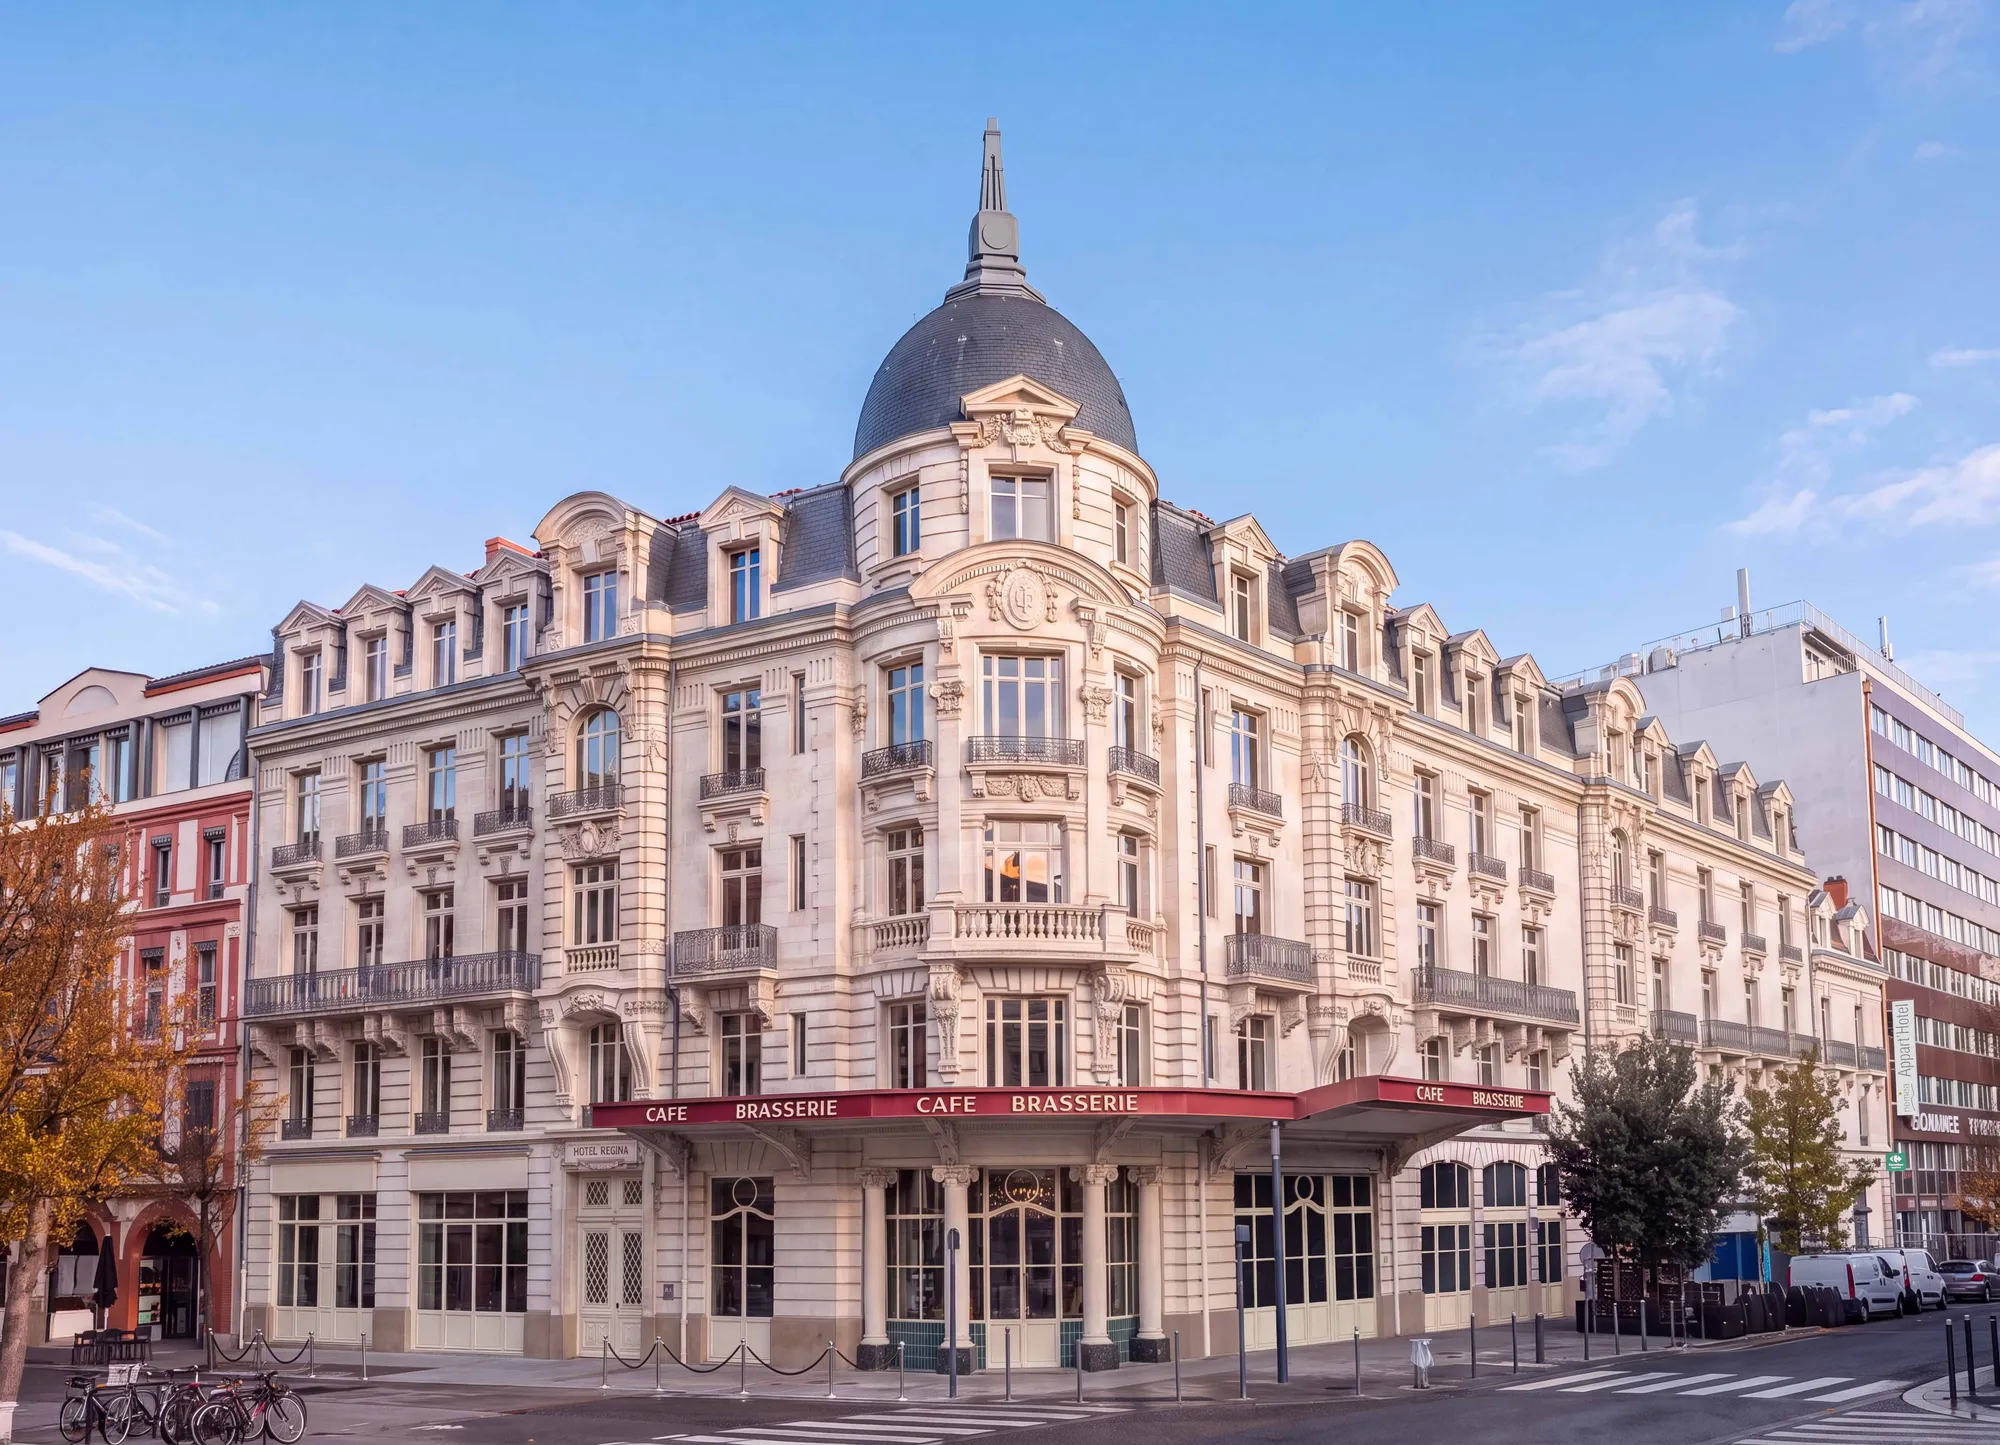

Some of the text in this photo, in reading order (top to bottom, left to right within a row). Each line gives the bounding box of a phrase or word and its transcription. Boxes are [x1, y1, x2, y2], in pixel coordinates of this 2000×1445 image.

[1894, 1003, 1915, 1077] Appart'Hotel
[916, 1094, 1139, 1113] CAFE BRASSERIE
[1416, 1086, 1524, 1108] CAFE BRASSERIE
[645, 1099, 839, 1122] CAFE BRASSERIE
[573, 1145, 629, 1157] HOTEL REGINA
